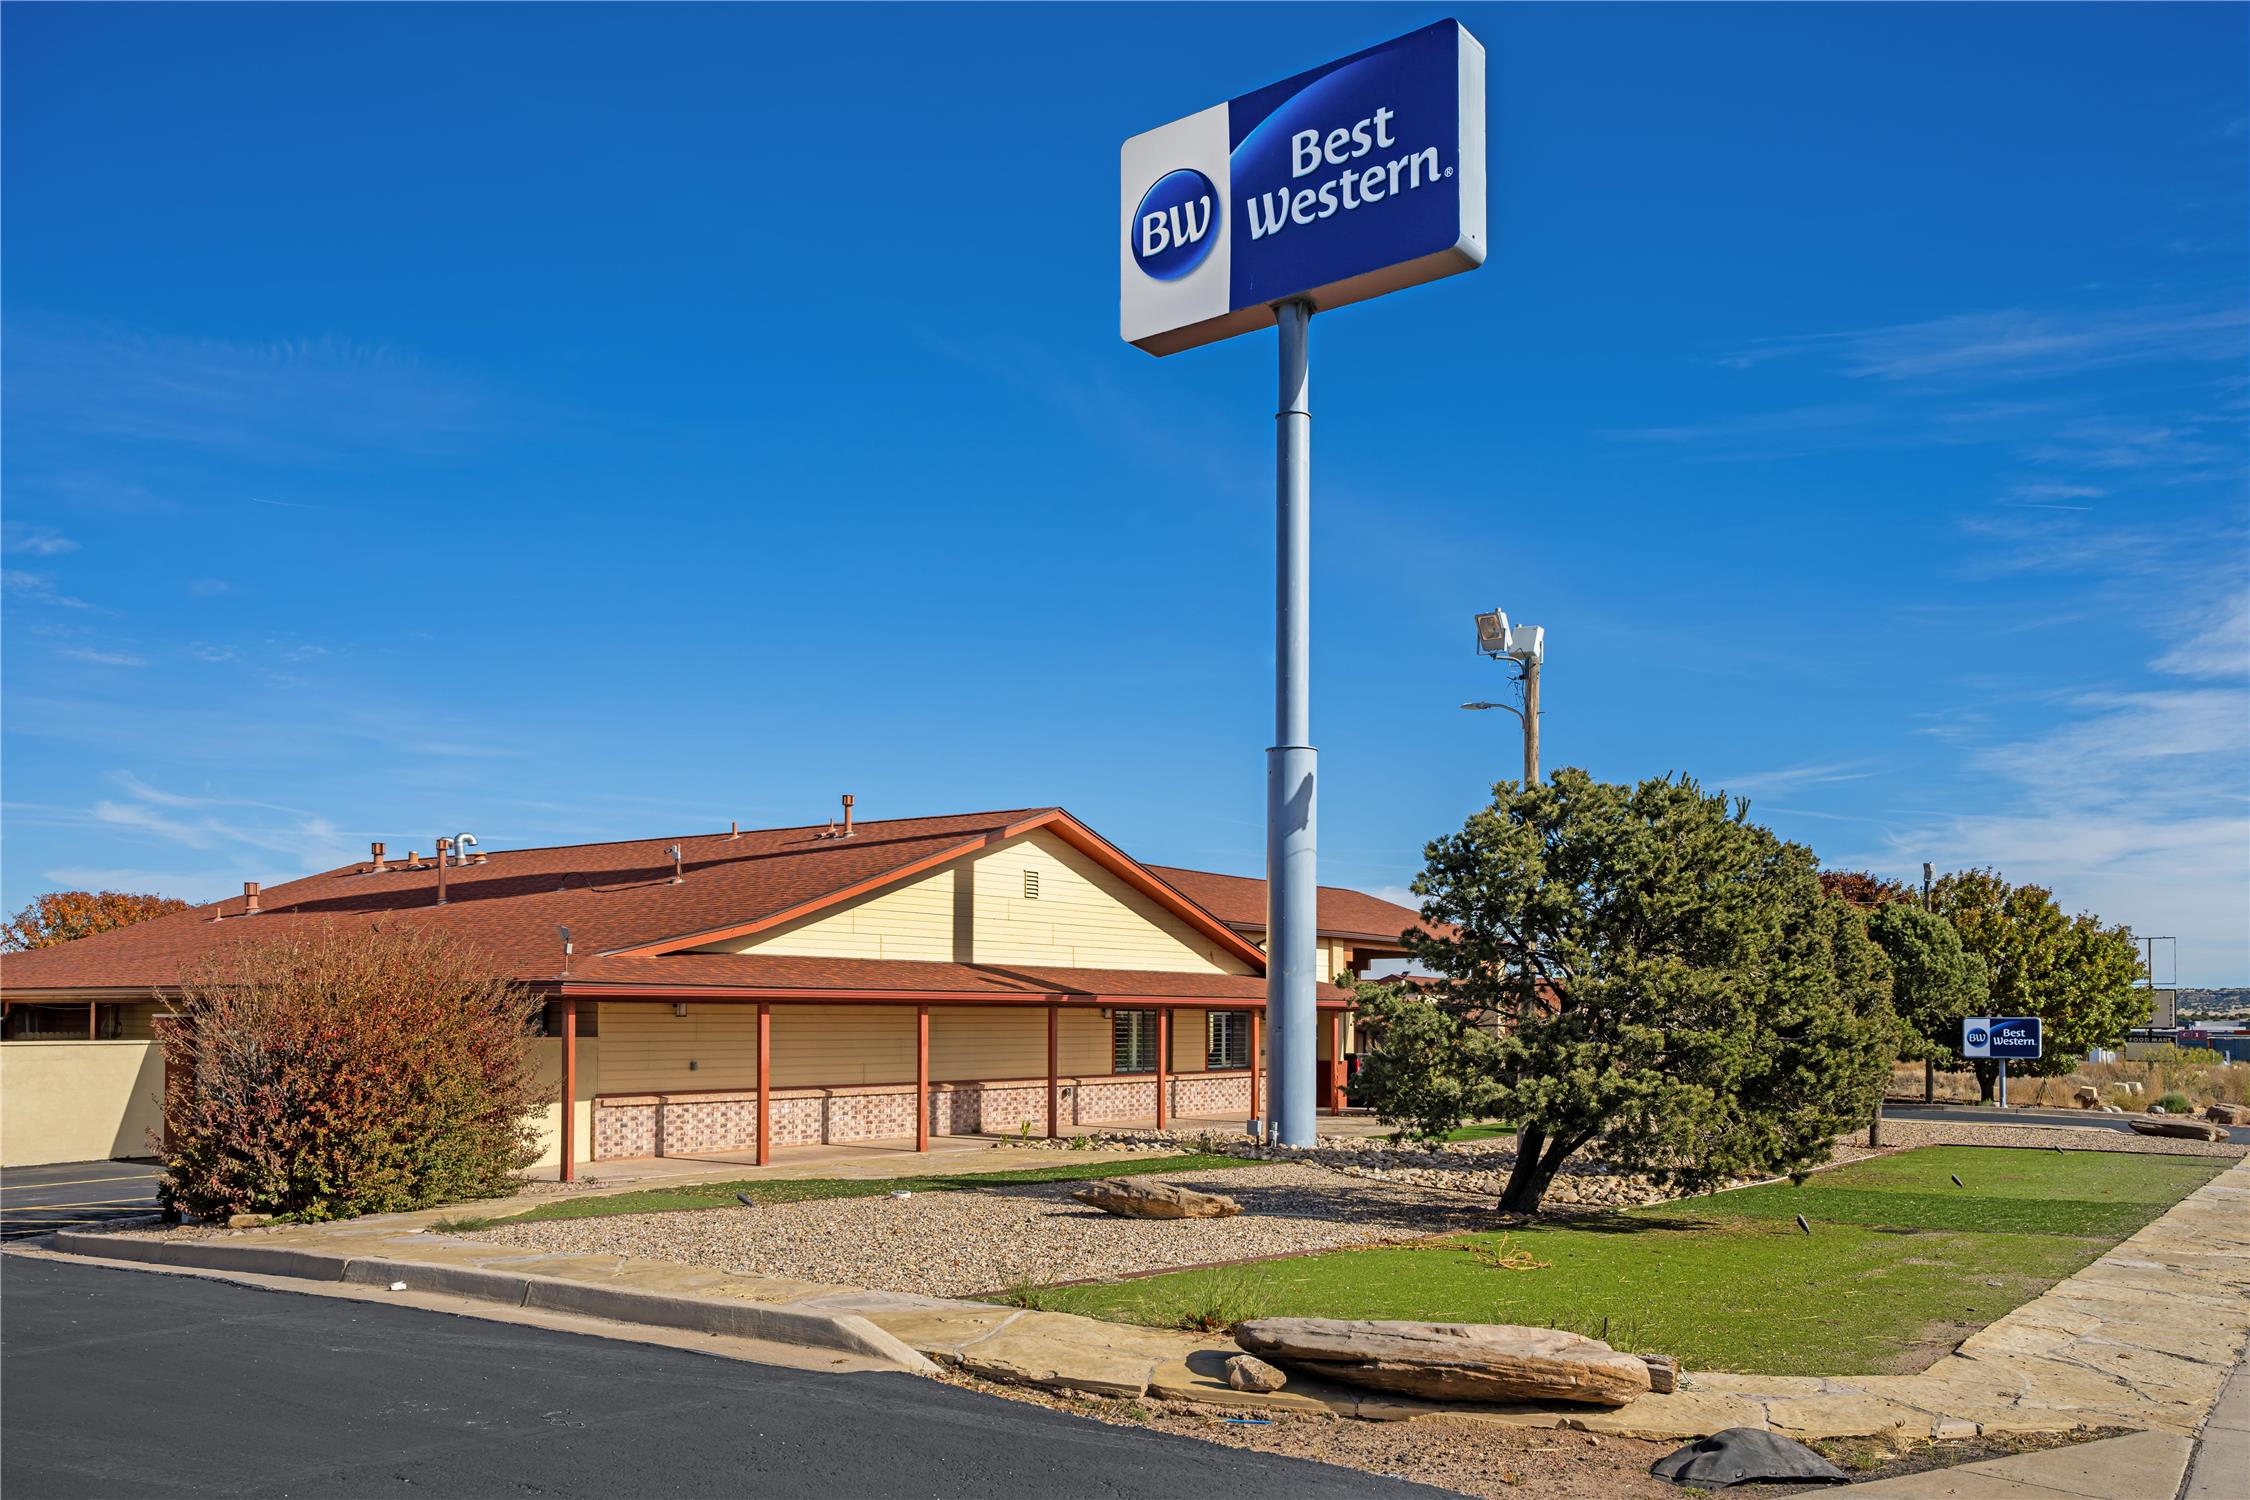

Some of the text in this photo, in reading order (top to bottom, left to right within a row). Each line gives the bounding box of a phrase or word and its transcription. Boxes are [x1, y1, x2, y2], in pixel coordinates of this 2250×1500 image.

[1292, 106, 1395, 178] Best
[1142, 195, 1211, 257] BW
[2003, 1028, 2025, 1037] Best
[1969, 1033, 1986, 1042] BW
[1993, 1037, 2035, 1046] Western
